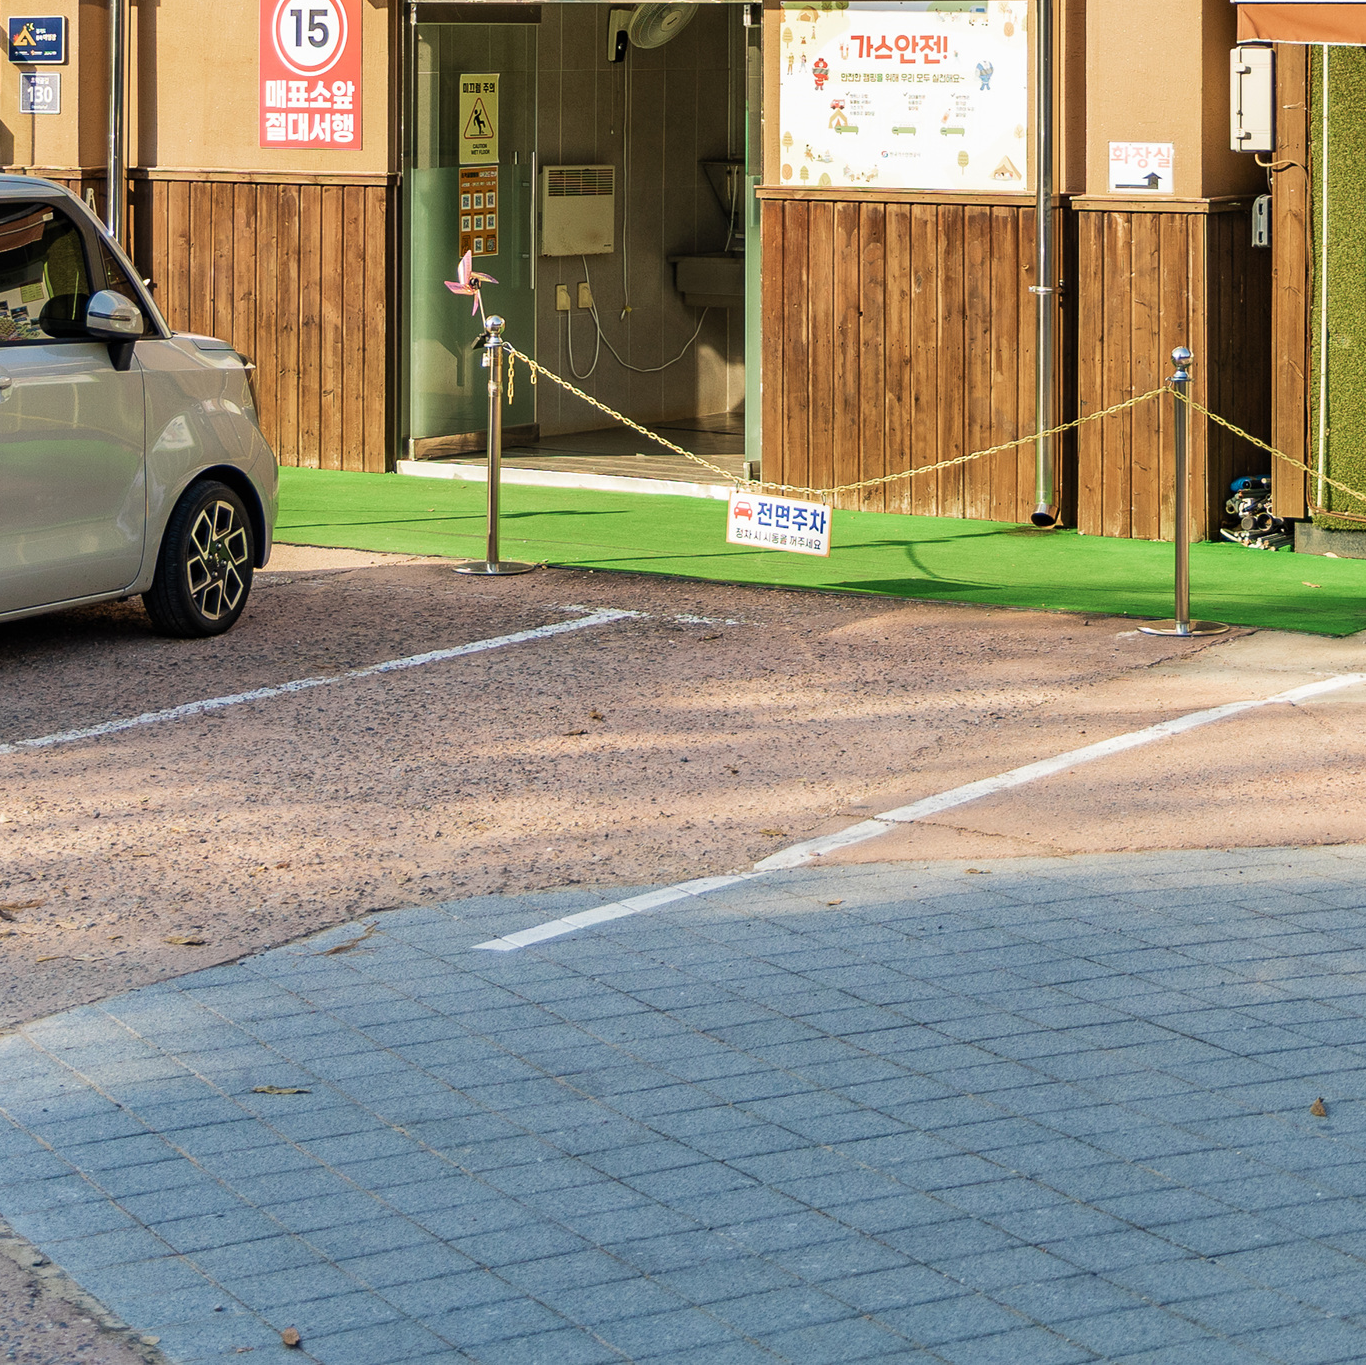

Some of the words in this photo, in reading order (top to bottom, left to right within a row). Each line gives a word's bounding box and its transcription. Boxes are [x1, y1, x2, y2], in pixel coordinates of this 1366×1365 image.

[290, 9, 329, 48] 15
[850, 35, 948, 64] 가스안전!
[483, 82, 496, 94] 주의
[900, 73, 915, 83] 우리
[916, 73, 930, 83] 모두
[27, 86, 53, 103] 130
[265, 80, 355, 110] 매표소앞
[265, 112, 354, 143] 절대서행
[1110, 145, 1171, 169] 화장실
[757, 501, 827, 534] 전면주차
[736, 527, 752, 540] 정차
[754, 530, 762, 541] 시
[763, 531, 788, 545] 시동을
[789, 535, 821, 550] 꺼주세요
